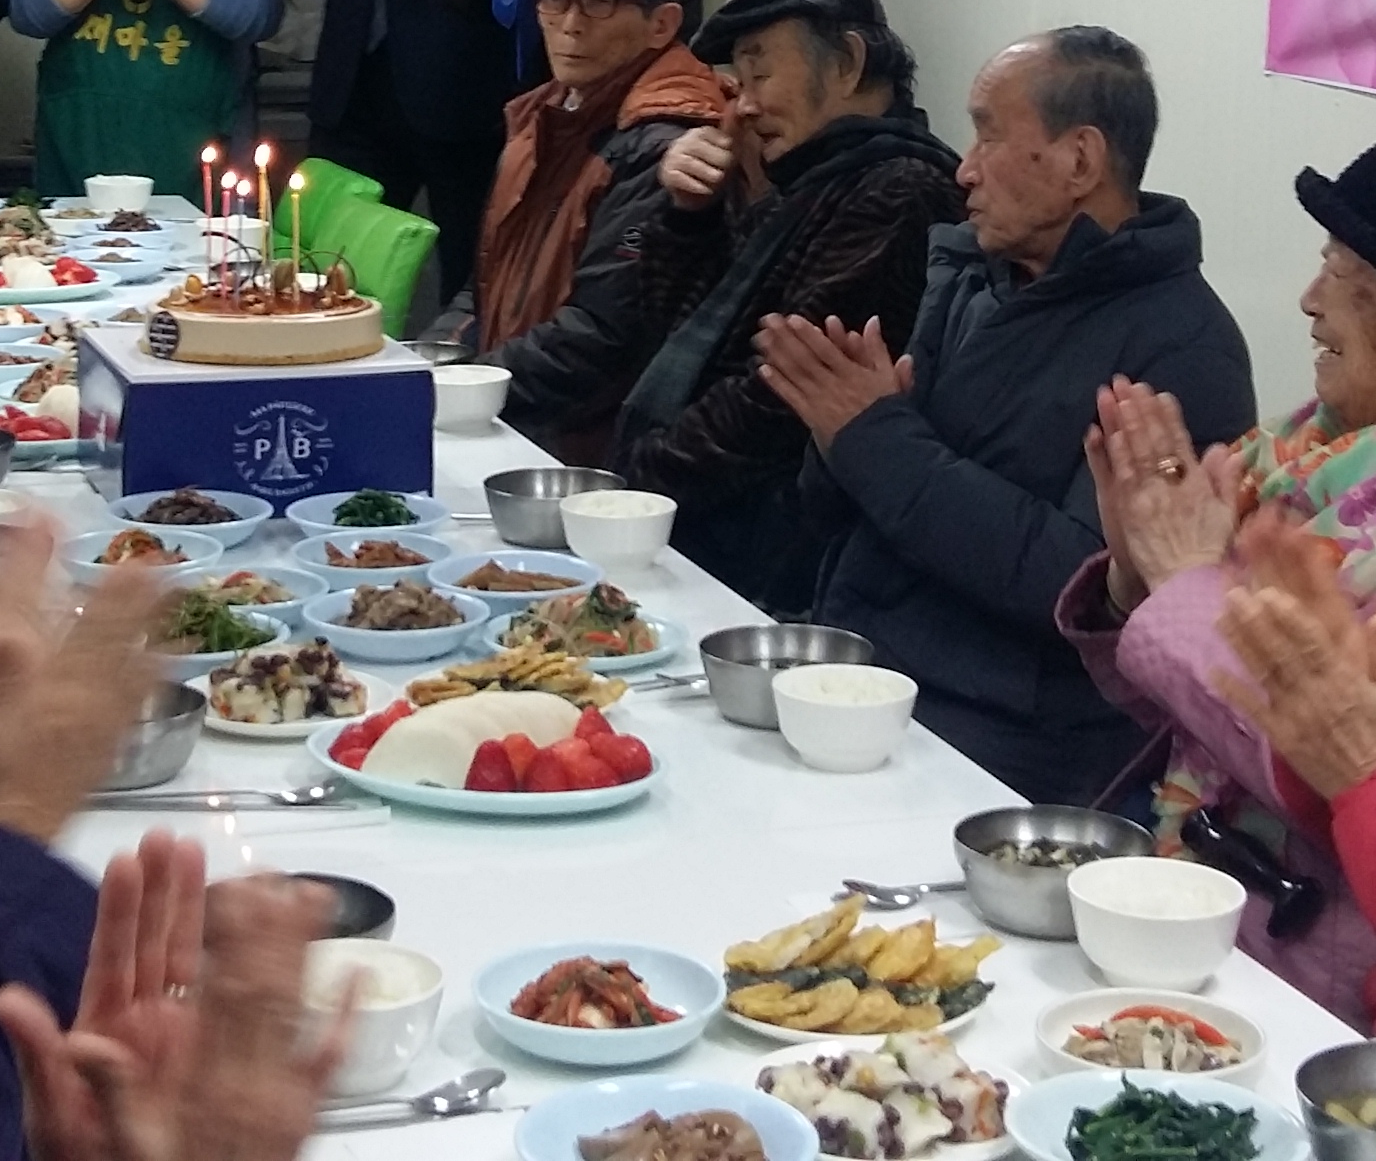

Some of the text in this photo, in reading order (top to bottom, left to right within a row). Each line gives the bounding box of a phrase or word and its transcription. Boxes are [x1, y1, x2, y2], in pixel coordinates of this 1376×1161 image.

[74, 13, 192, 66] 새마을
[254, 437, 312, 460] P B
